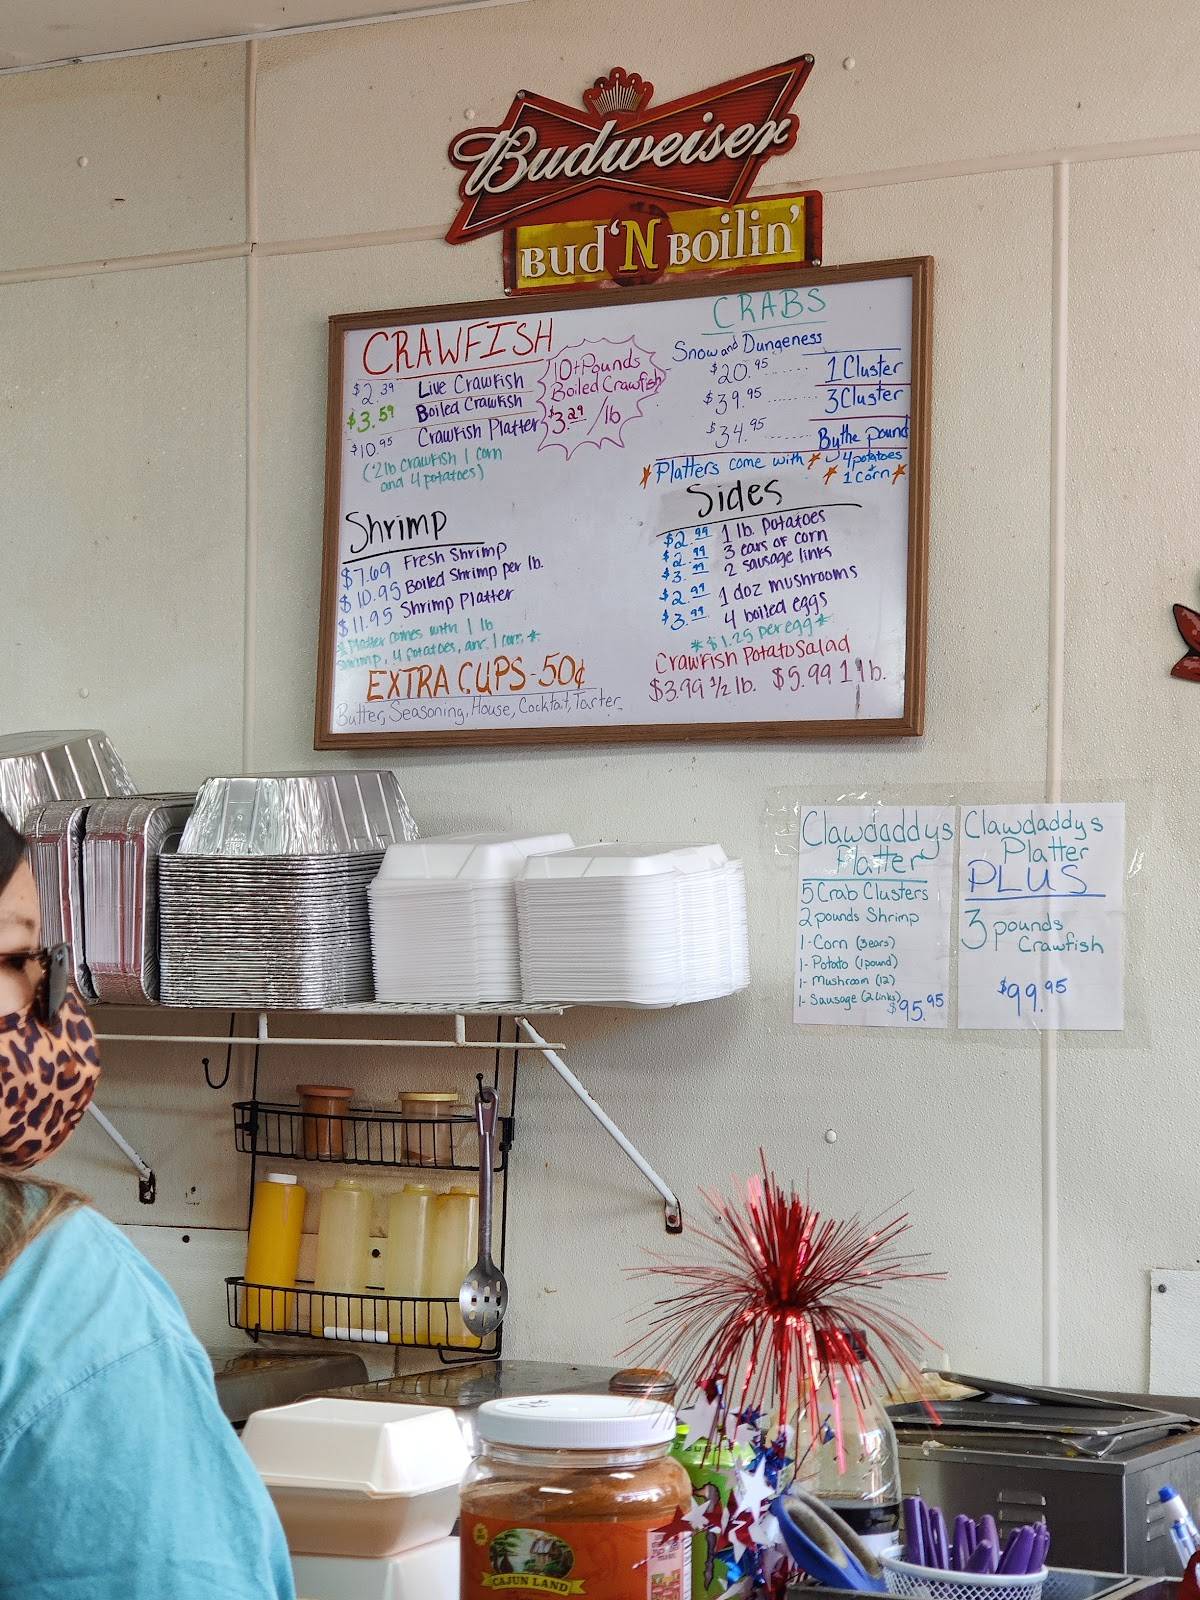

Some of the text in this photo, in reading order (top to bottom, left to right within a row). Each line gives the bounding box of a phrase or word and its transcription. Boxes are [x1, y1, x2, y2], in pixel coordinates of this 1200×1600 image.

[454, 112, 789, 197] Budweiser
[713, 288, 826, 329] CRABS
[363, 317, 553, 376] CRAWFISH
[672, 333, 823, 361] Snow and Dungeness
[551, 368, 662, 402] Boiled Crawfish
[710, 357, 769, 384] $20.95
[843, 354, 904, 379] Cluster
[352, 372, 524, 406] $2.39 Live Crawfish
[703, 387, 762, 415] $39.95
[841, 380, 904, 408] Cluster
[347, 395, 523, 433] $3.59 Boiled Crawfish
[351, 418, 539, 459] $10.95 Crawfish Platter
[706, 417, 767, 449] $34.95
[380, 476, 404, 493] and
[411, 471, 421, 488] 4
[654, 455, 720, 484] Platters
[729, 457, 766, 471] come
[773, 452, 805, 467] with
[687, 479, 783, 518] Sides
[345, 511, 447, 554] Shrimp
[721, 523, 733, 544] 1
[724, 544, 735, 560] 3
[740, 540, 768, 557] ears
[773, 535, 787, 548] of
[795, 529, 828, 545] corn
[341, 542, 507, 590] $7.69 Fresh Shrimp
[724, 562, 737, 577] 2
[743, 550, 793, 572] sausage
[799, 545, 832, 563] links
[339, 581, 401, 613] $10.95
[405, 572, 445, 595] Boiled
[449, 563, 498, 583] Shrimp
[503, 561, 521, 580] per
[719, 586, 729, 607] 1
[733, 582, 762, 601] doz
[768, 565, 858, 594] mushrooms
[338, 587, 514, 637] $11.95 Shrimp Platter
[724, 610, 736, 629] 4
[744, 598, 786, 623] boiled
[793, 591, 828, 616] eggs
[758, 622, 784, 639] per
[785, 617, 813, 637] egg
[655, 650, 738, 674] Crawfish
[366, 663, 450, 702] EXTRA
[802, 808, 953, 860] Clawdaddys
[964, 808, 1104, 841] Clawdaddys
[836, 844, 925, 876] Platter
[1000, 836, 1089, 865] Platter
[800, 881, 929, 904] 5 Crab Clusters
[967, 859, 1088, 895] PLUS
[799, 907, 920, 930] 2 pounds Shrimp
[961, 908, 1064, 952] 3 pounds
[813, 934, 848, 951] Corn
[1018, 931, 1104, 954] Crawfish
[811, 955, 849, 971] Potato
[810, 993, 858, 1011] Sausage
[492, 1576, 569, 1593] CAJUN LAND
